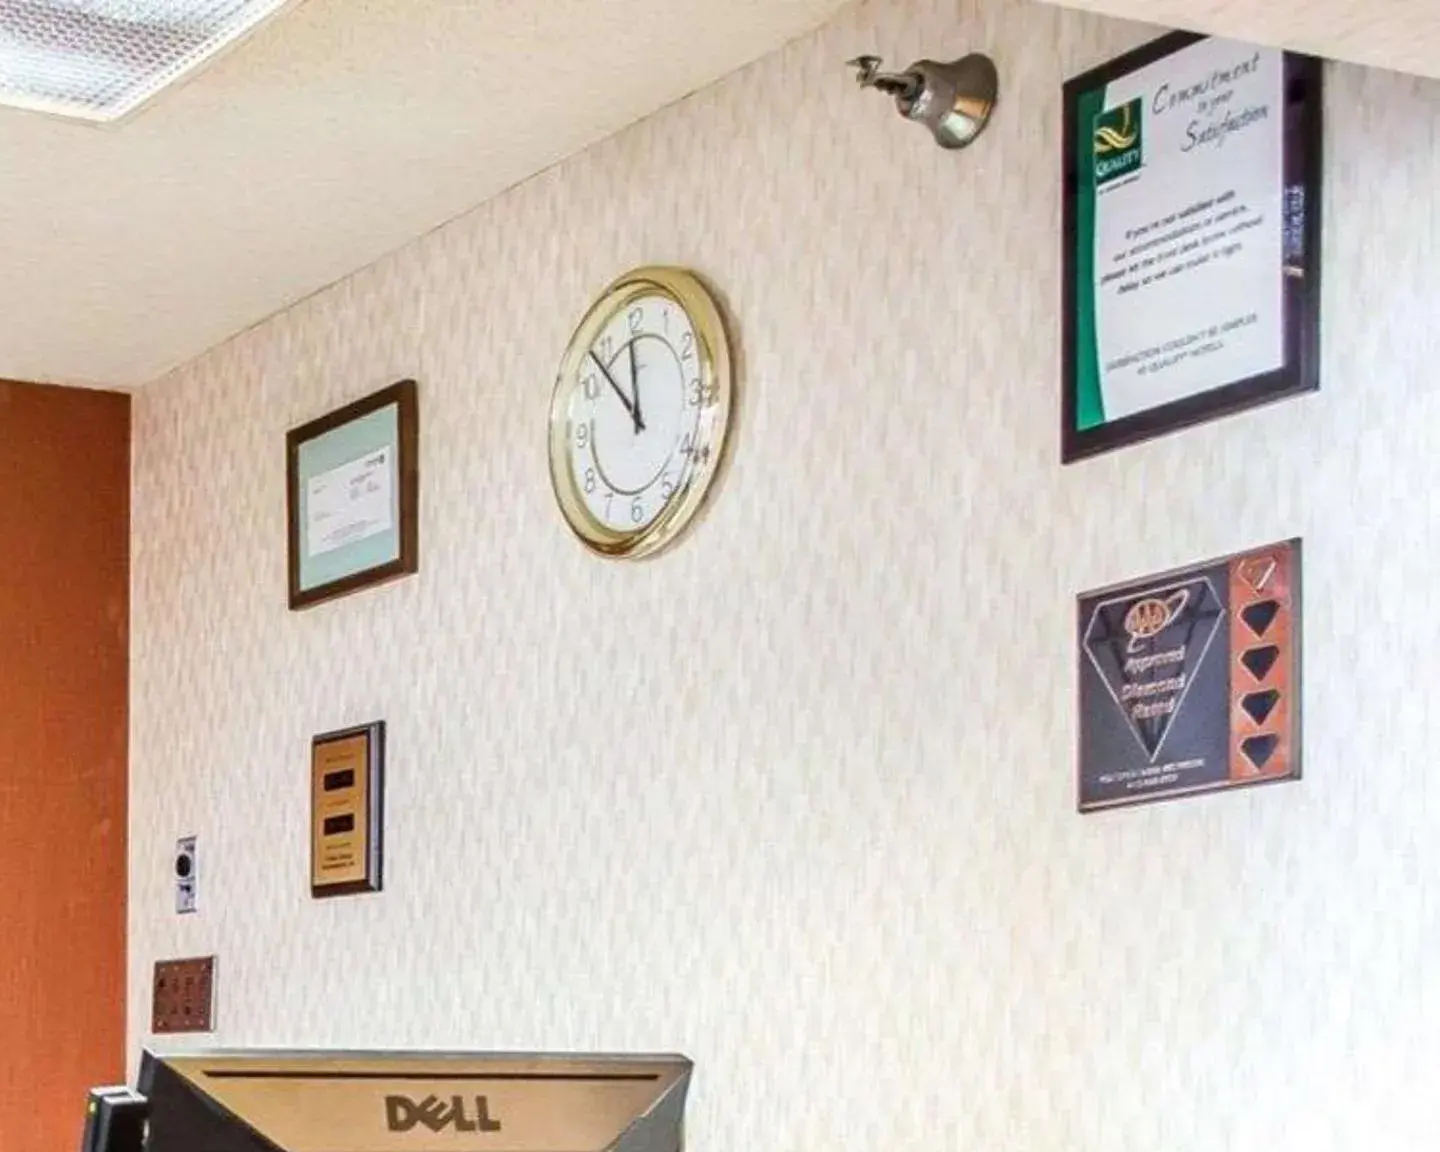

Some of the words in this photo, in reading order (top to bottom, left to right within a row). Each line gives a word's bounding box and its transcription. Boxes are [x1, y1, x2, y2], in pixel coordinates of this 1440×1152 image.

[681, 331, 693, 361] 2
[689, 378, 703, 406] 3
[576, 422, 589, 449] 9
[583, 467, 596, 495] 8
[631, 496, 644, 523] 6
[384, 1094, 502, 1133] DELL
